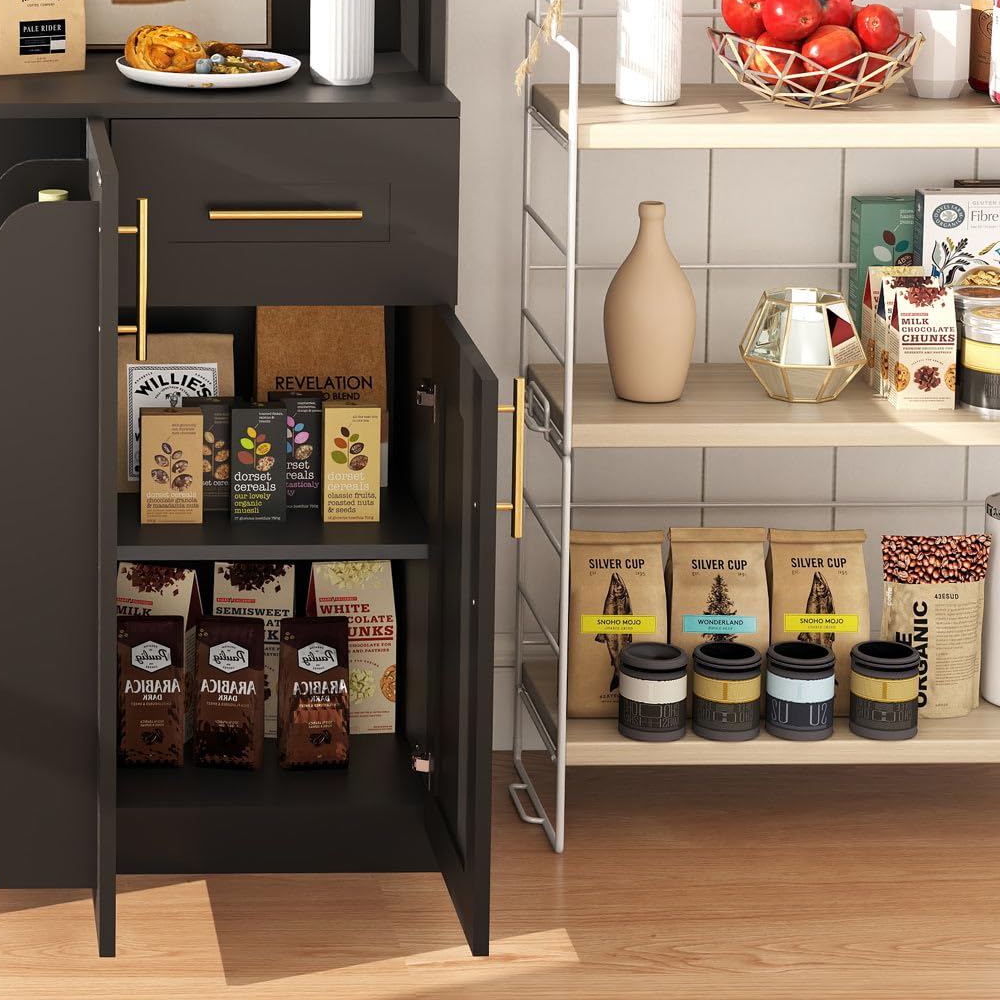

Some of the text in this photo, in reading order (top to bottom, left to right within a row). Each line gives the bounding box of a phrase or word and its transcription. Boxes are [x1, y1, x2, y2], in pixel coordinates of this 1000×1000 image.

[971, 210, 999, 222] Fibre
[902, 334, 955, 343] CHUNKS
[134, 373, 212, 398] WILLIE'S
[276, 375, 373, 391] REVELATION
[332, 392, 360, 400] BLEND
[234, 472, 272, 481] dorset
[328, 472, 365, 480] dorset
[234, 482, 277, 492] cereals
[328, 482, 369, 491] cereals
[589, 558, 645, 569] SILVER CUP
[692, 560, 748, 571] SILVER CUP
[791, 558, 847, 569] SILVER CUP
[117, 606, 152, 617] MILK
[216, 607, 290, 617] SEMISWEET
[320, 604, 370, 614] WHITE
